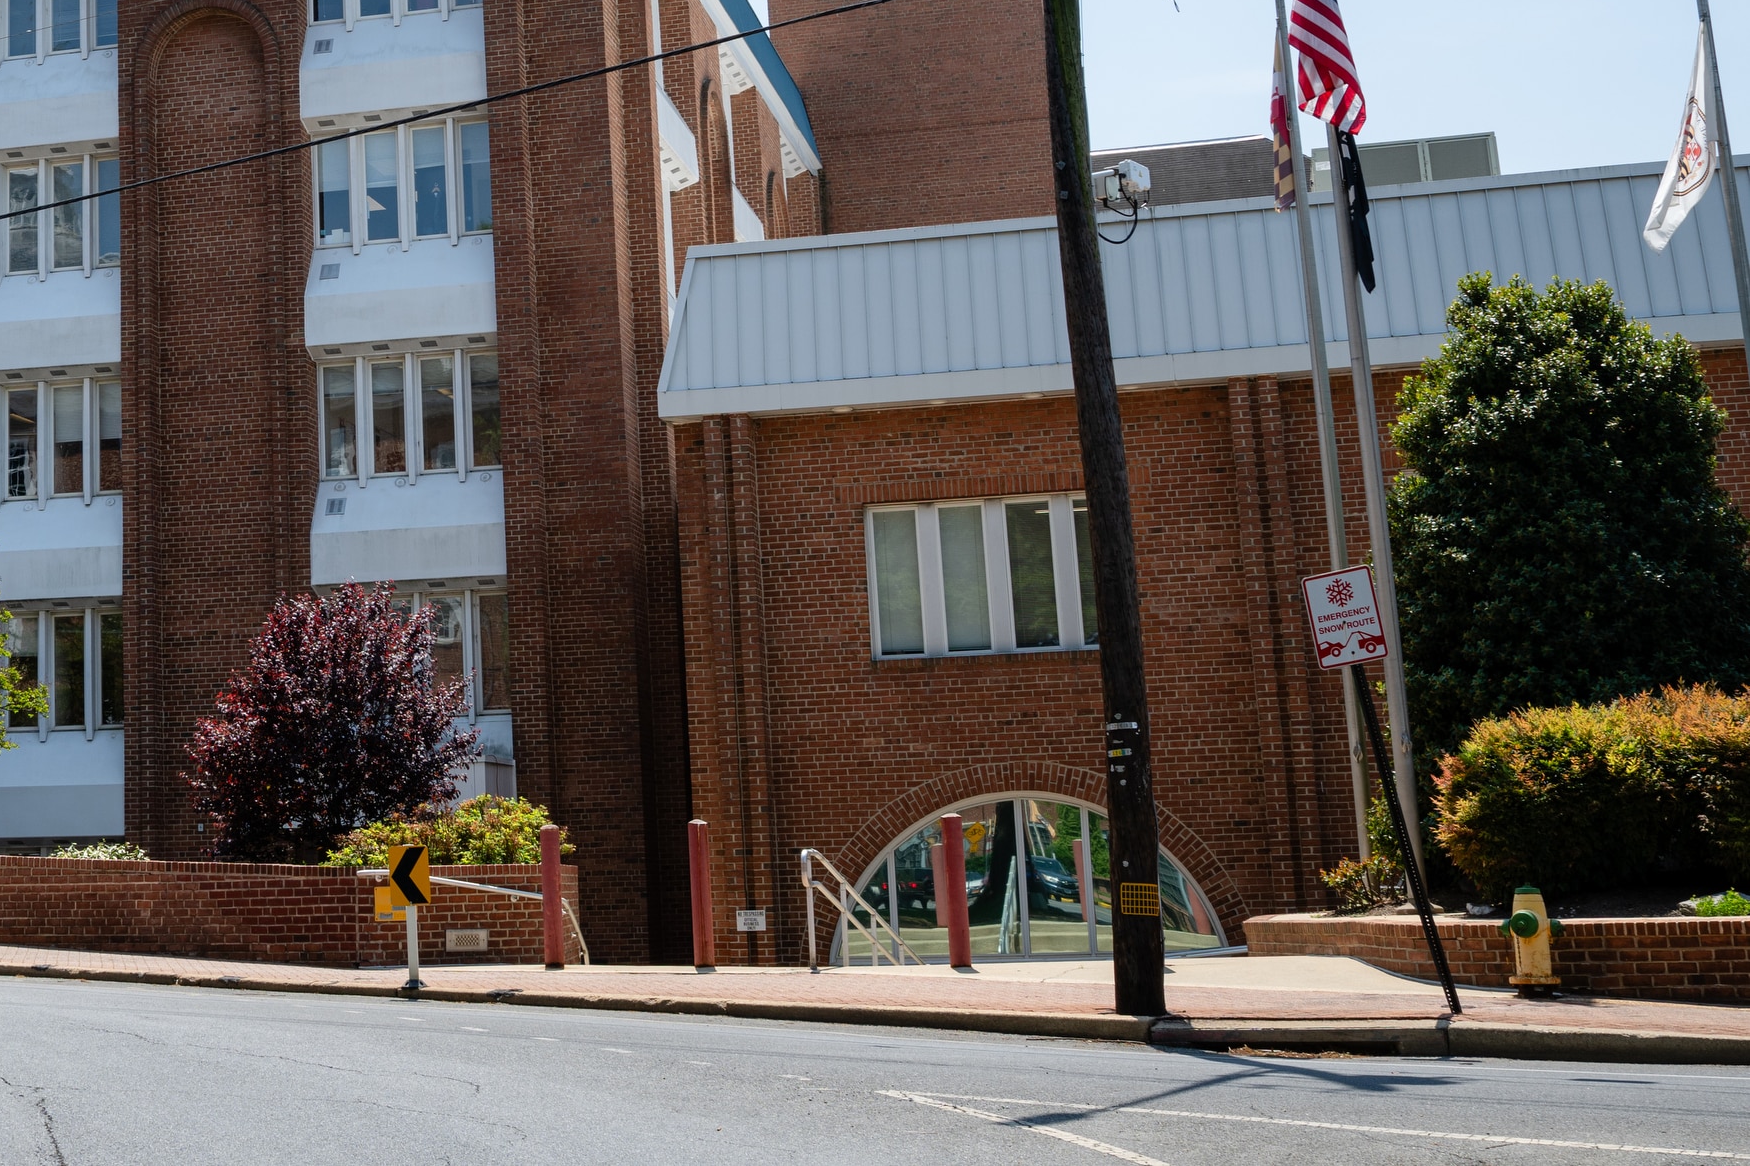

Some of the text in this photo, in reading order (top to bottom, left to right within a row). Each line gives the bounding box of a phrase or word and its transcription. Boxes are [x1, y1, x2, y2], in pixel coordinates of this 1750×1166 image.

[1317, 605, 1371, 623] EMERGENCY
[1318, 616, 1376, 635] SNOW ROUTE
